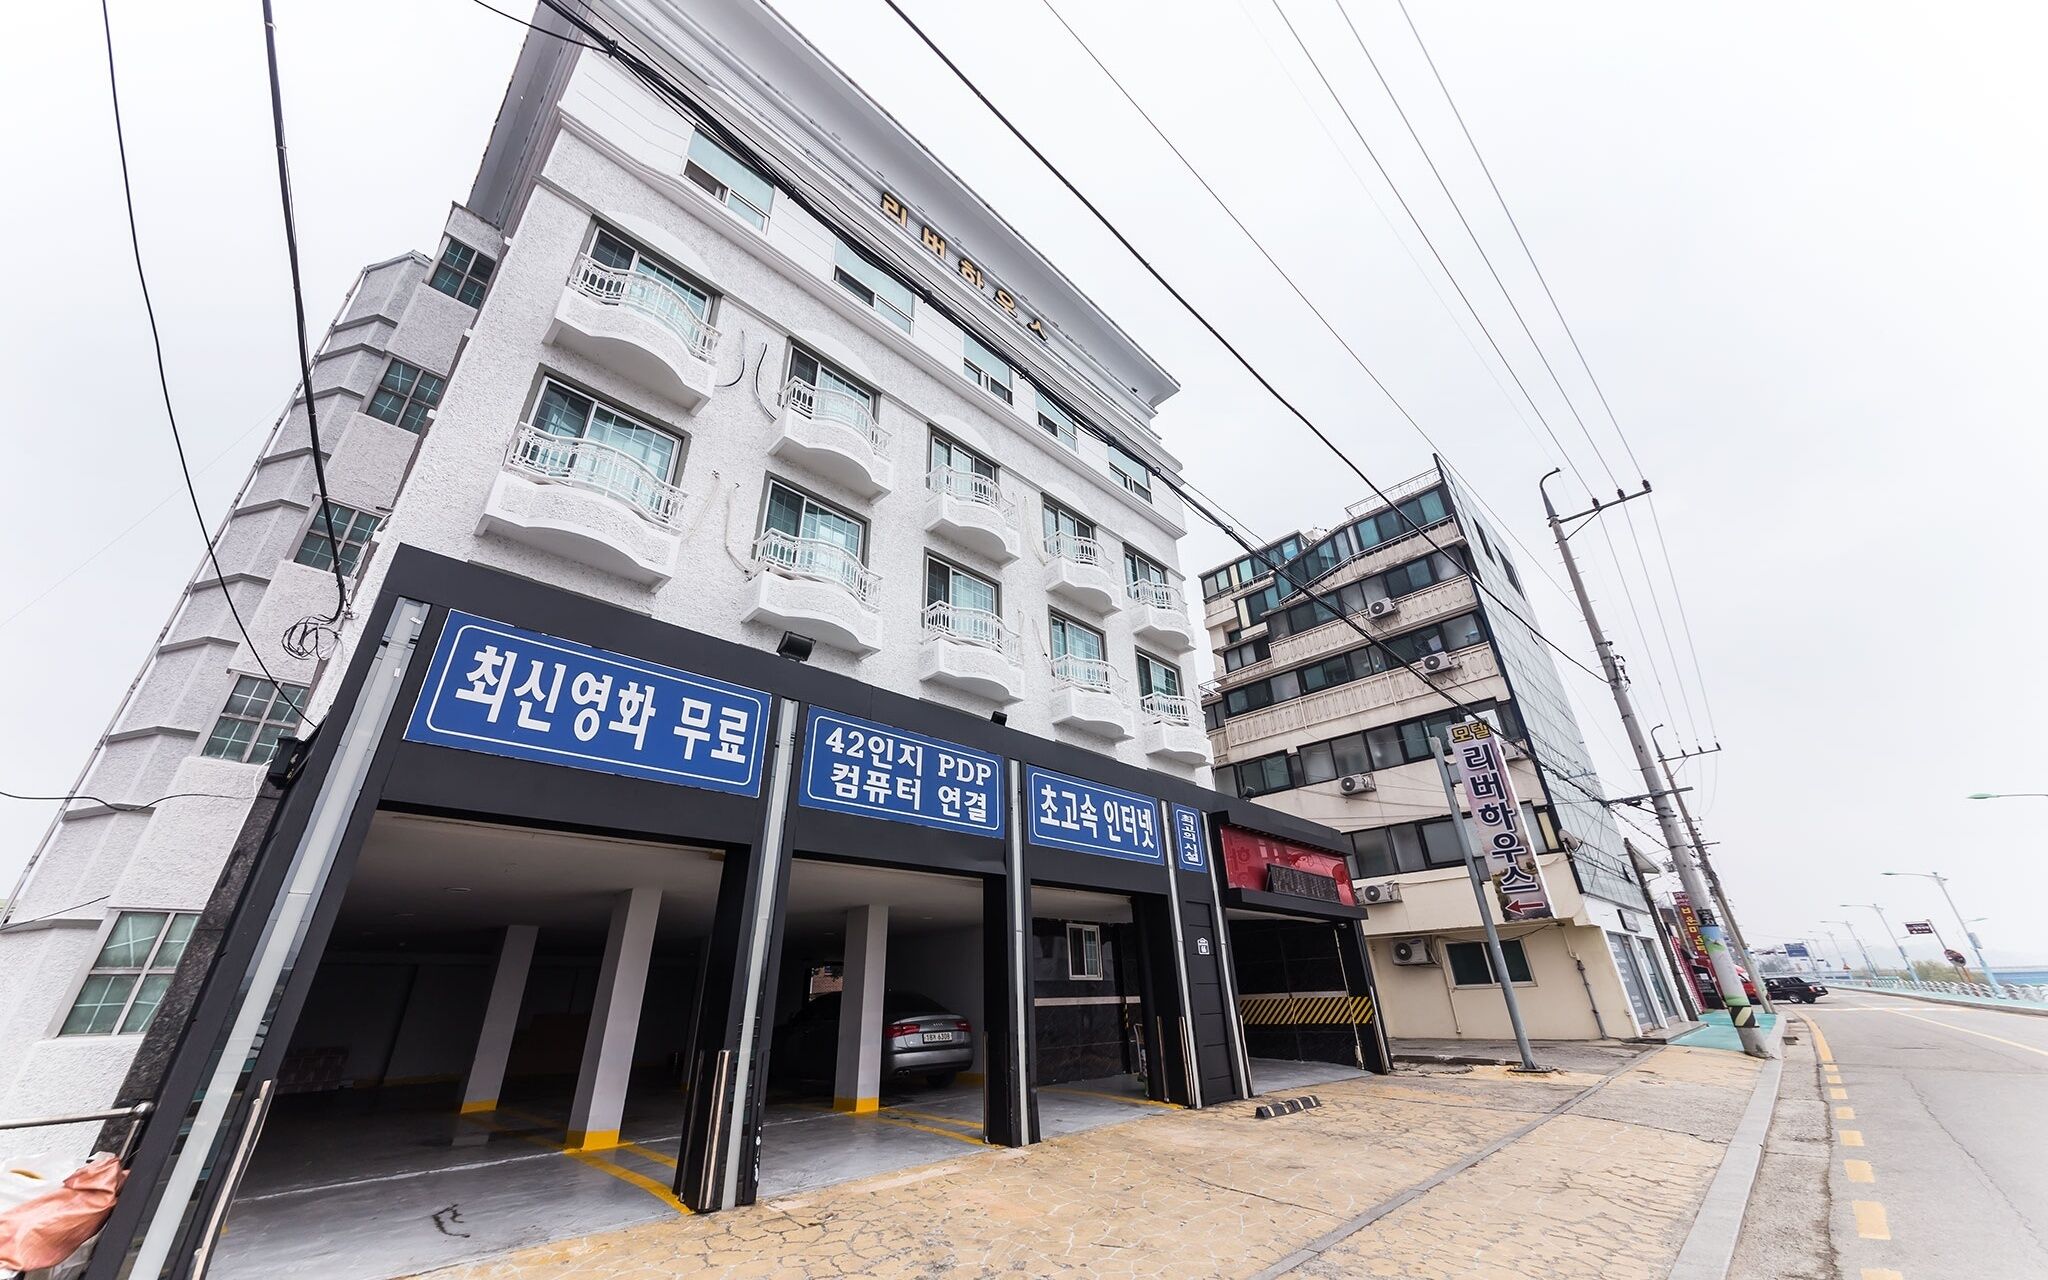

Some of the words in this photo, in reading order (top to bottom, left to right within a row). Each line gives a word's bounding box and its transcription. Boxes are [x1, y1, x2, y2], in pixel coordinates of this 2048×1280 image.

[455, 644, 657, 751] 최신영화
[673, 697, 748, 765] 무료
[1452, 721, 1491, 743] 모텔
[825, 726, 923, 777] 42인지
[938, 753, 992, 787] PDP
[829, 762, 922, 811] 컴퓨터
[938, 785, 988, 824] 연결
[1040, 783, 1099, 839] 초고속
[1103, 800, 1155, 850] 인터넷
[1463, 743, 1539, 894] 리버하우스
[1181, 814, 1196, 843] 최고의
[1184, 843, 1199, 863] 시설
